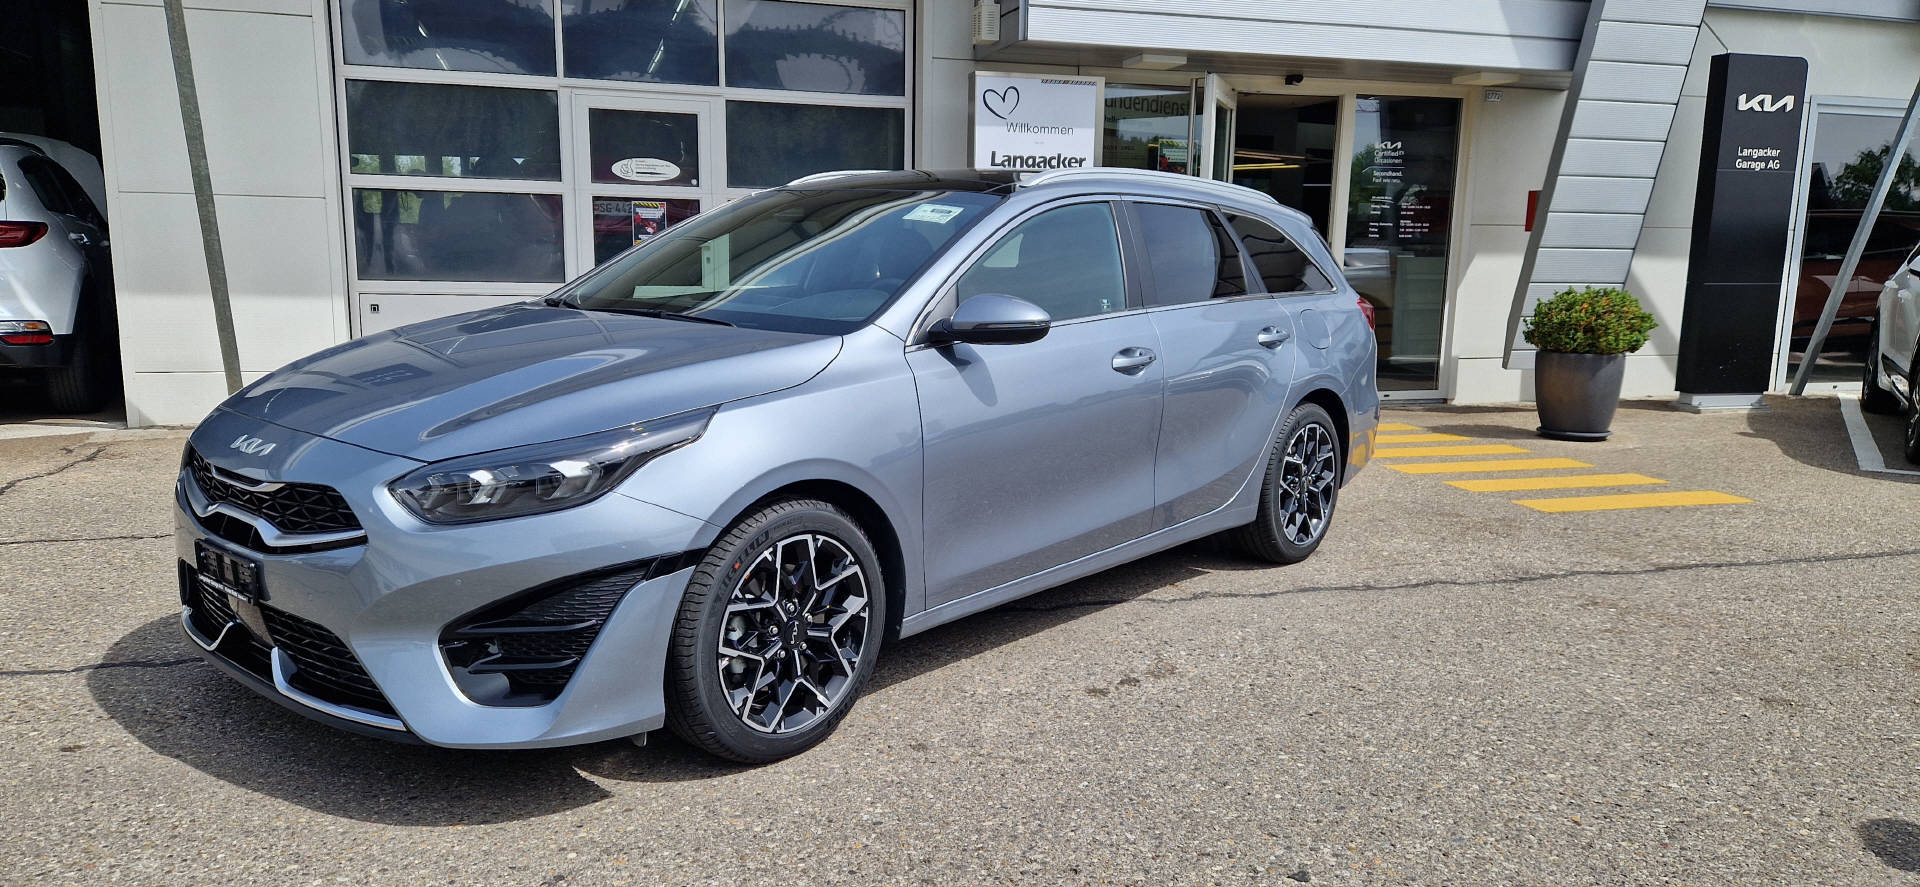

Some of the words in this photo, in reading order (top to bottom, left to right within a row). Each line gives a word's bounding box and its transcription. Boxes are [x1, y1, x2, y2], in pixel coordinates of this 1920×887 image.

[1738, 93, 1795, 112] KIA
[1006, 121, 1074, 136] Willkommen
[990, 150, 1087, 169] Langacker
[1738, 146, 1780, 158] Langacker
[1735, 158, 1766, 172] Garage
[1766, 159, 1781, 170] AG
[229, 434, 277, 457] KIA
